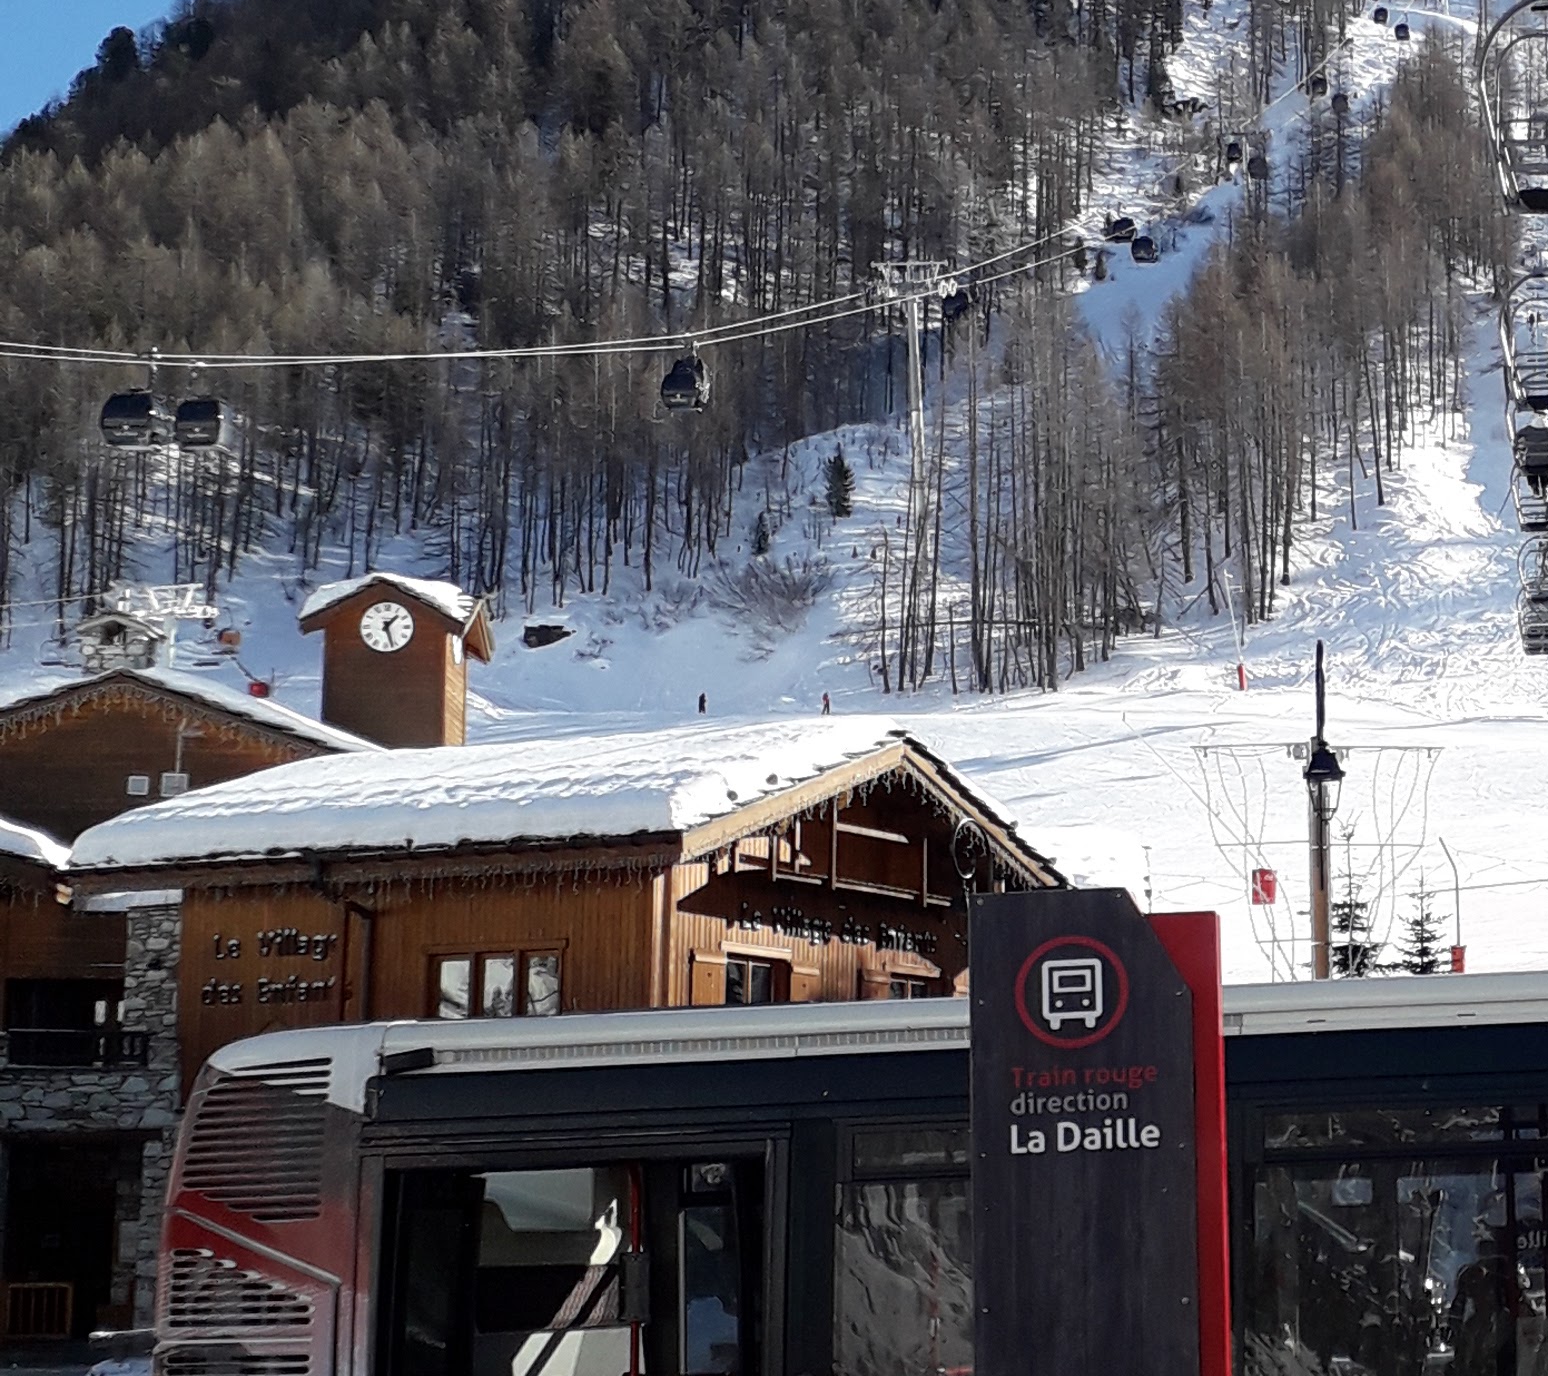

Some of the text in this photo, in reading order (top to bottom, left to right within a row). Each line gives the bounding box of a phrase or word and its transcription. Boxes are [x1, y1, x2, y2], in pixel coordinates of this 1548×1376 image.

[1012, 1065, 1158, 1088] Train rouge
[1010, 1089, 1129, 1115] direction
[1010, 1117, 1161, 1154] La Daille
